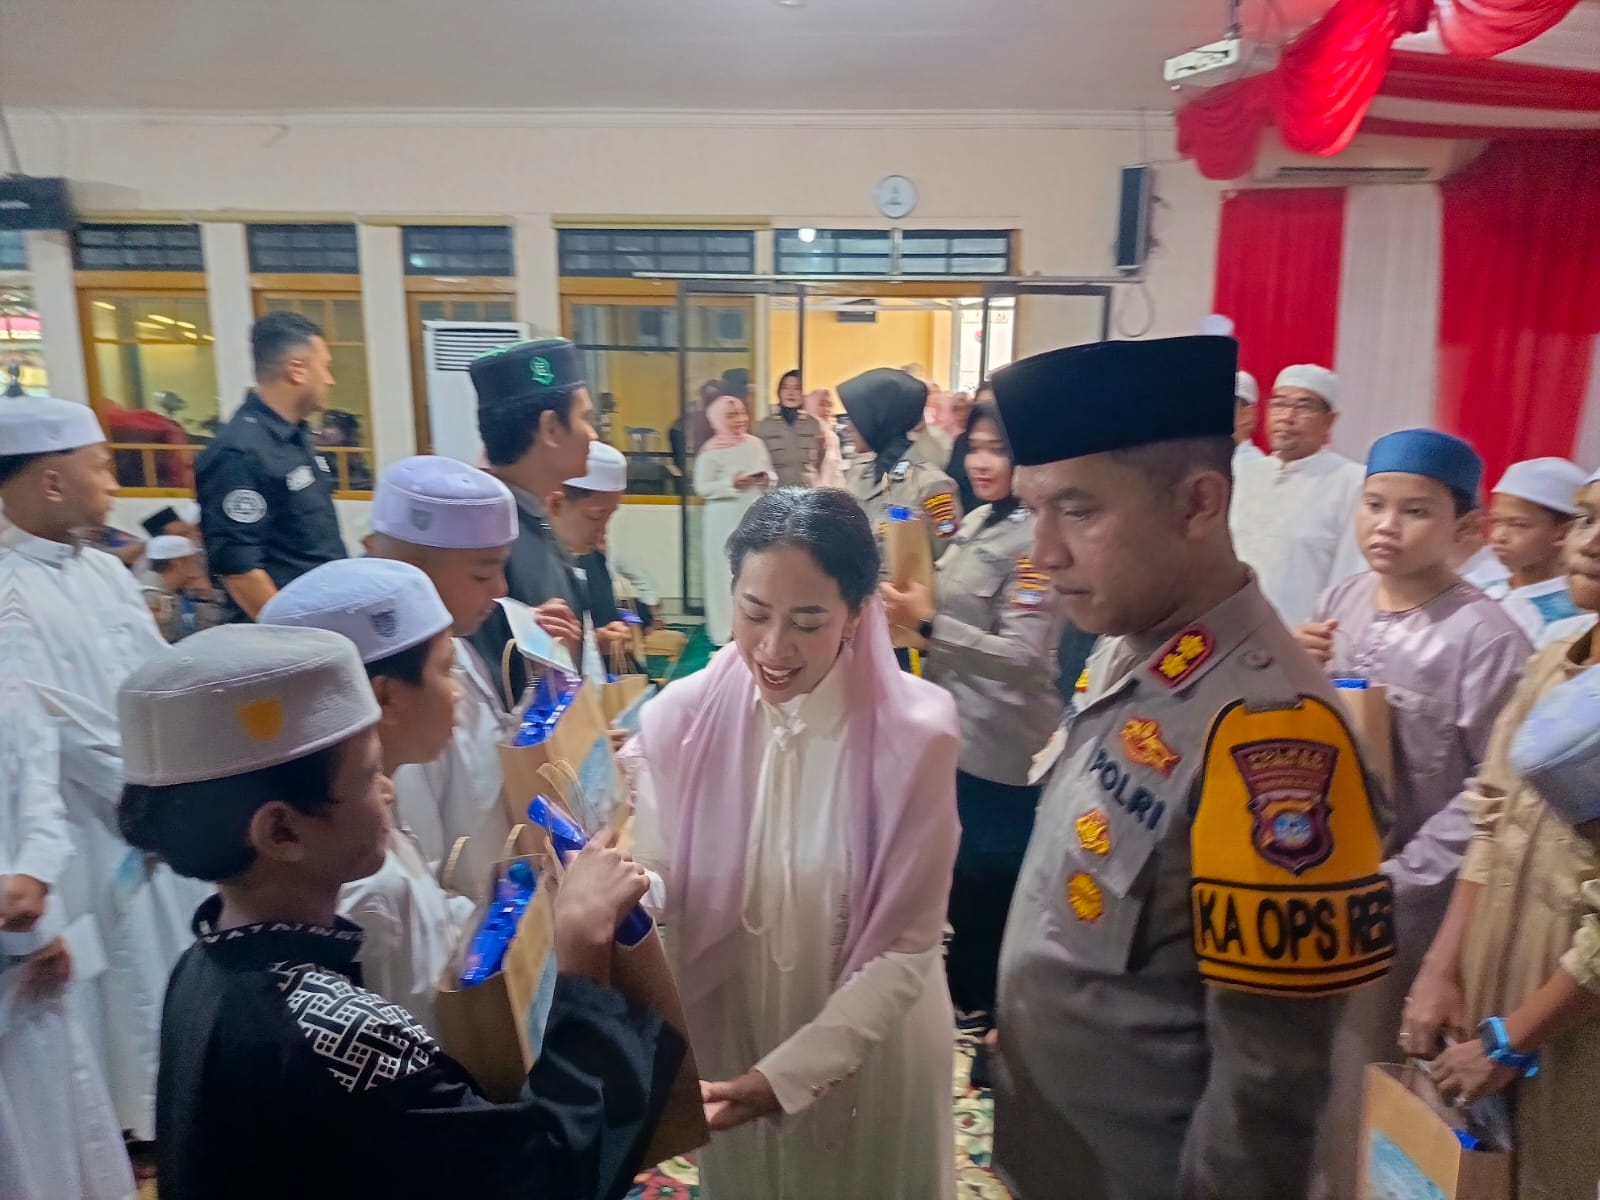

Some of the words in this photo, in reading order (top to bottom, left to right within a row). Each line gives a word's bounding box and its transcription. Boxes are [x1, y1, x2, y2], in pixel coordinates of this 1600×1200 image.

[1089, 748, 1166, 830] POLRI
[1198, 889, 1247, 956] KA
[1257, 897, 1340, 962] OPS
